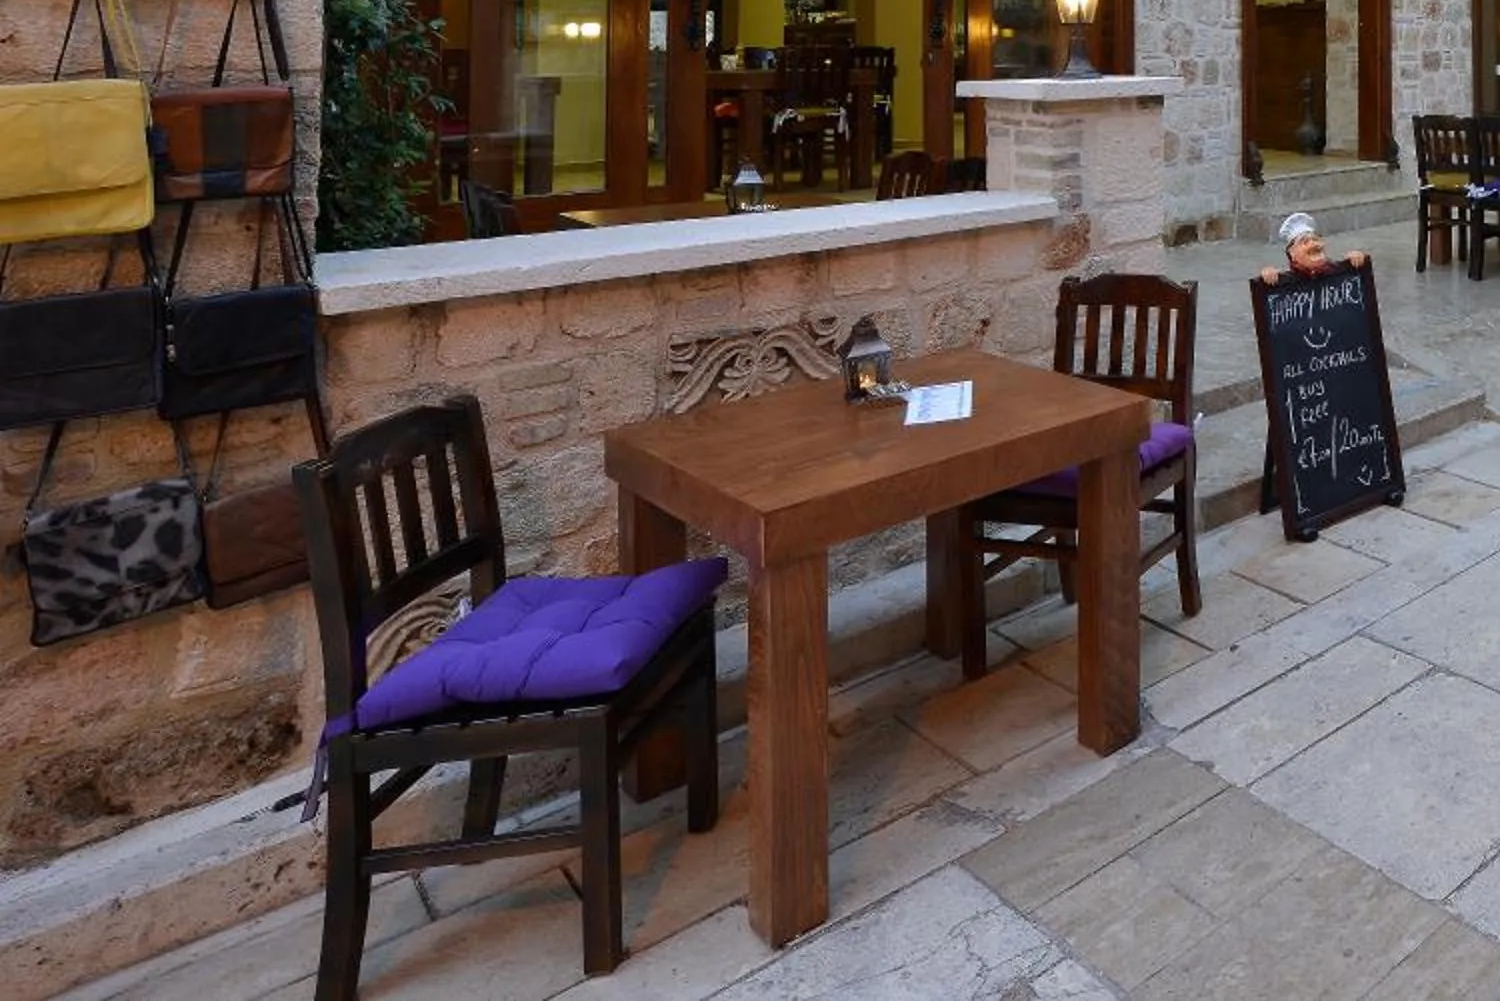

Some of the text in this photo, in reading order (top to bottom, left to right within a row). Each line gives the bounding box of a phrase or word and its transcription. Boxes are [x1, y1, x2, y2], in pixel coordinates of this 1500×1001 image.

[1271, 289, 1315, 325] HAPPY
[1283, 362, 1304, 379] ALL
[1299, 379, 1326, 400] BUY
